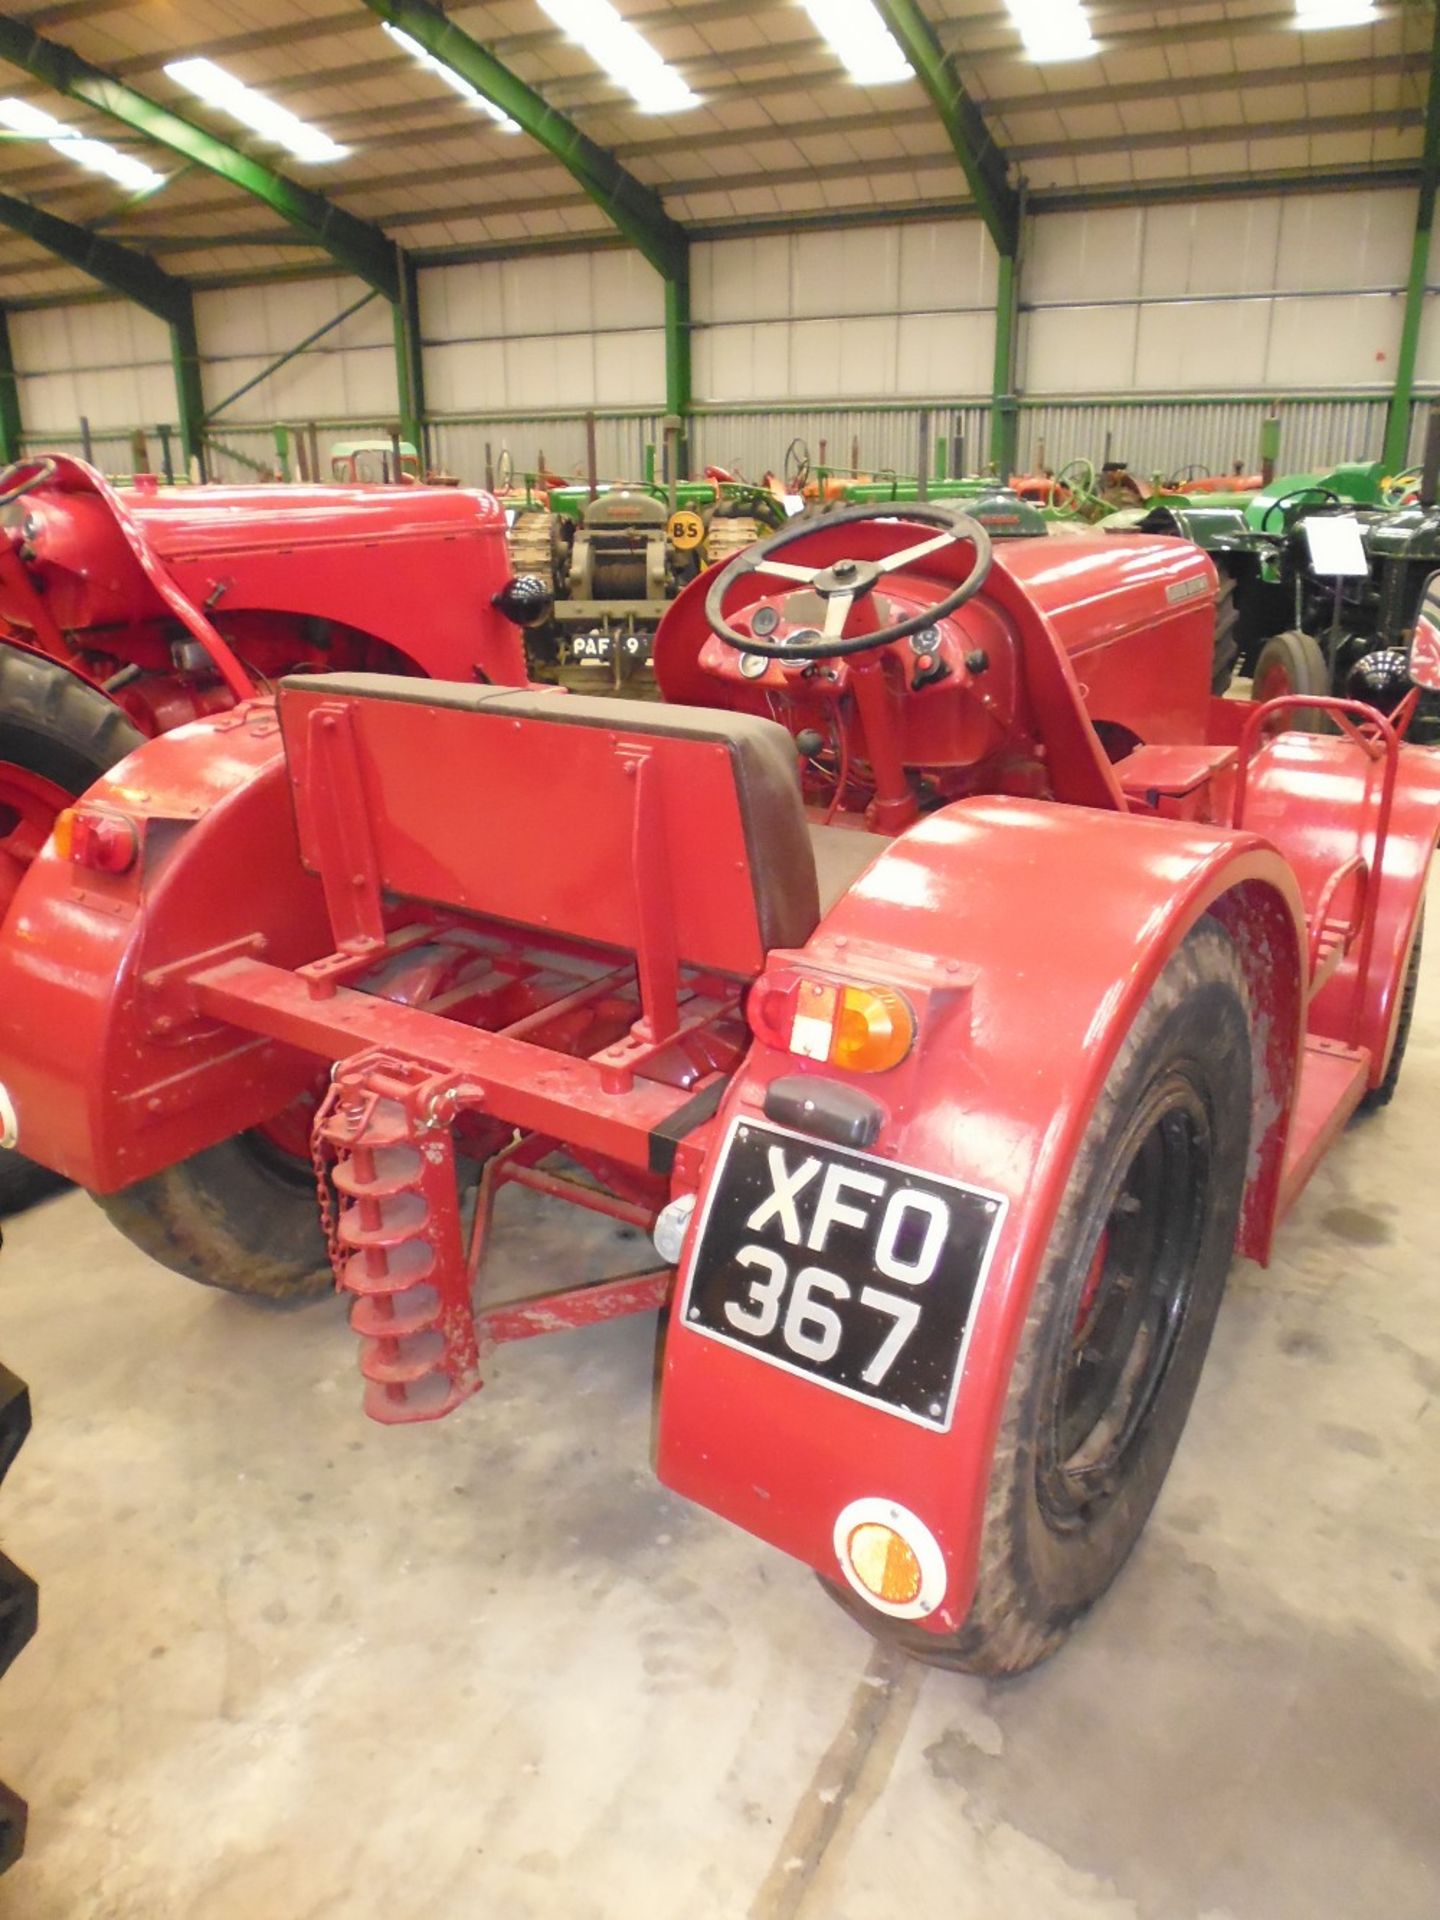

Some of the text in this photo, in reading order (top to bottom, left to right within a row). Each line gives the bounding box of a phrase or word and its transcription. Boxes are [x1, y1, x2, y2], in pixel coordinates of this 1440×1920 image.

[573, 637, 610, 655] PAF
[746, 1145, 950, 1286] XFO
[724, 1244, 922, 1387] 367
